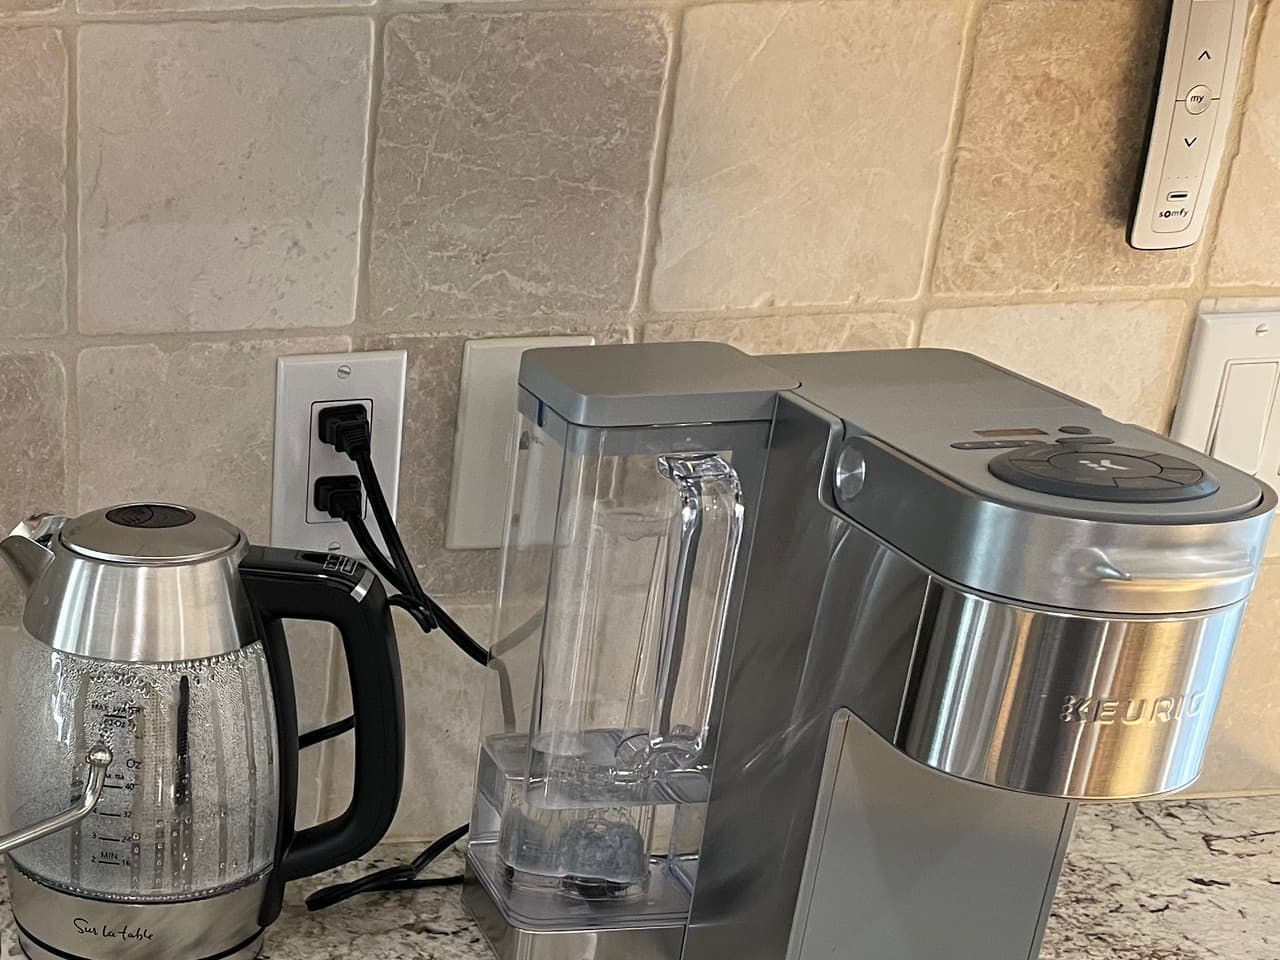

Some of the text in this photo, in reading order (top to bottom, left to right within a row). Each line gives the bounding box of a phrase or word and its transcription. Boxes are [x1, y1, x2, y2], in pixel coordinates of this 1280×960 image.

[1190, 94, 1205, 104] my
[1159, 207, 1189, 219] somfy
[101, 851, 118, 859] MIN
[73, 917, 154, 941] Sur la table
